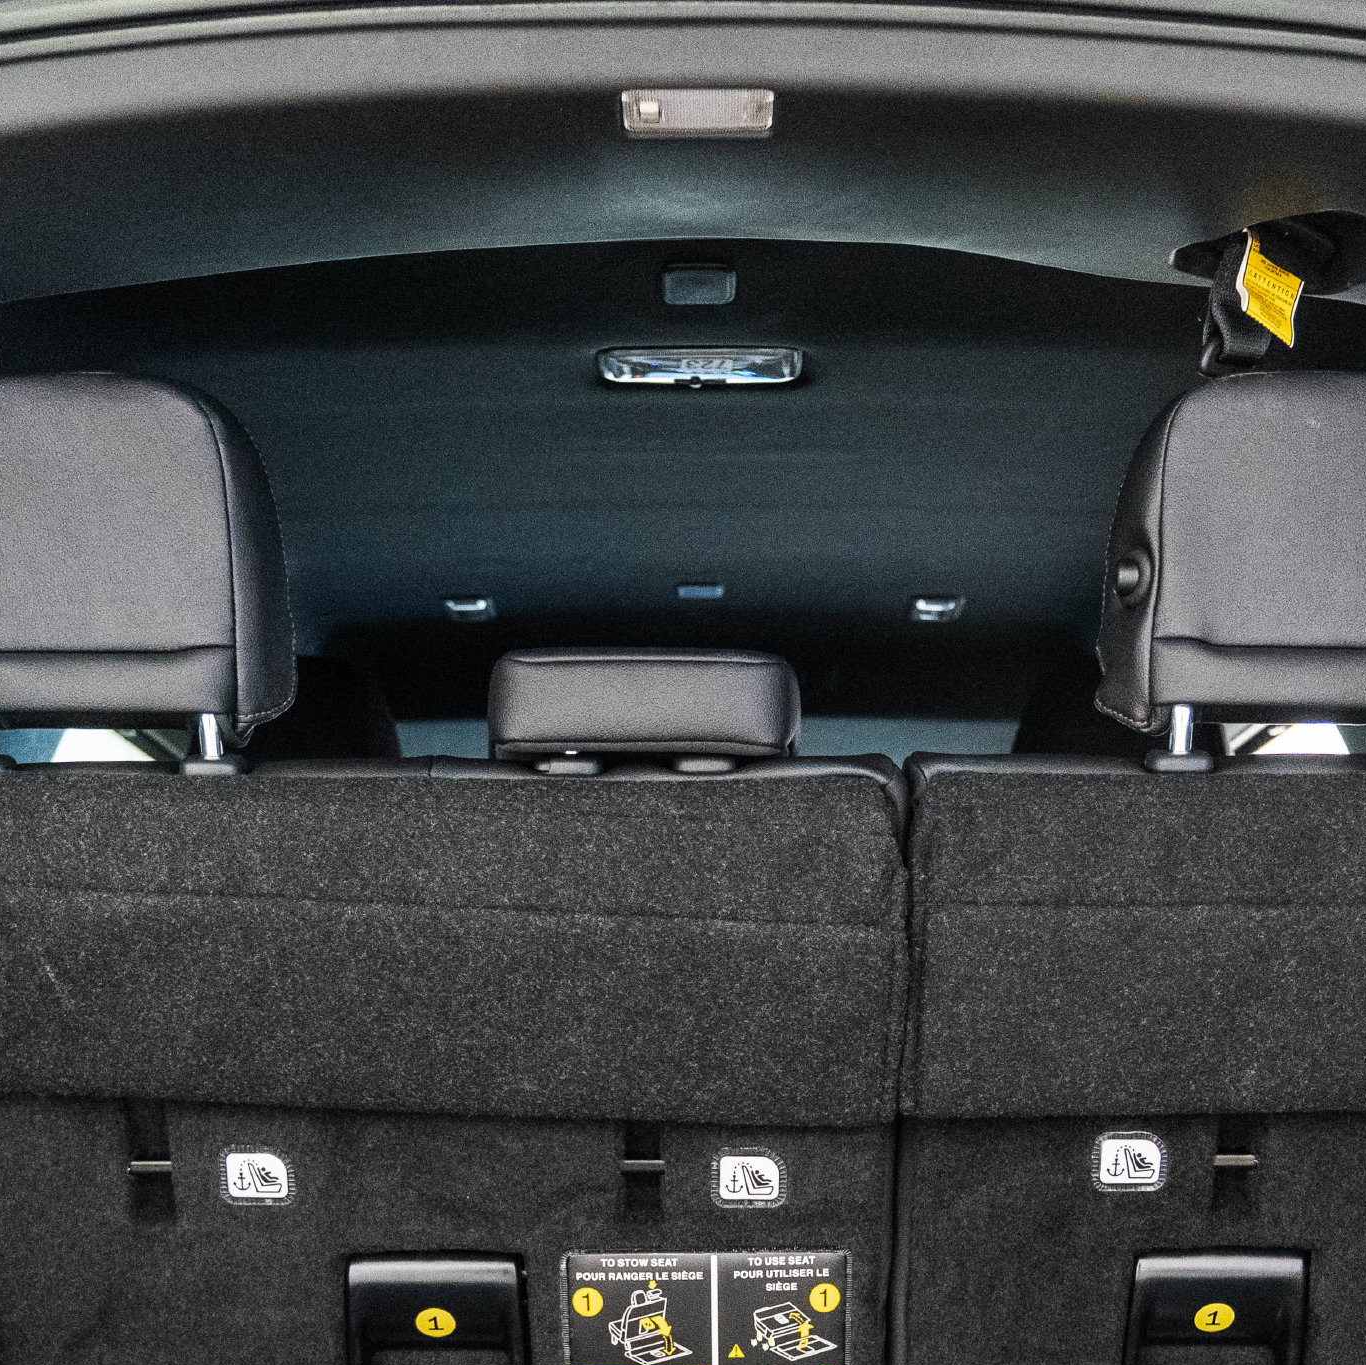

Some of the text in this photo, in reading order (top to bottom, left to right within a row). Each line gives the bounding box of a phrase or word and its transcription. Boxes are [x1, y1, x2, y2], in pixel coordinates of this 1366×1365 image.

[1253, 272, 1295, 300] ATTENTION
[600, 1258, 678, 1268] TO STOW SEAT
[748, 1256, 816, 1266] TO USE SEAT
[576, 1270, 704, 1281] POUR RANGER LE SIÈGE
[734, 1268, 830, 1279] POUR UTILISER LE
[765, 1281, 798, 1292] SIÈGE
[582, 1292, 590, 1312] 1
[820, 1288, 828, 1308] 1
[427, 1316, 445, 1331] 1
[1204, 1310, 1221, 1326] 1
